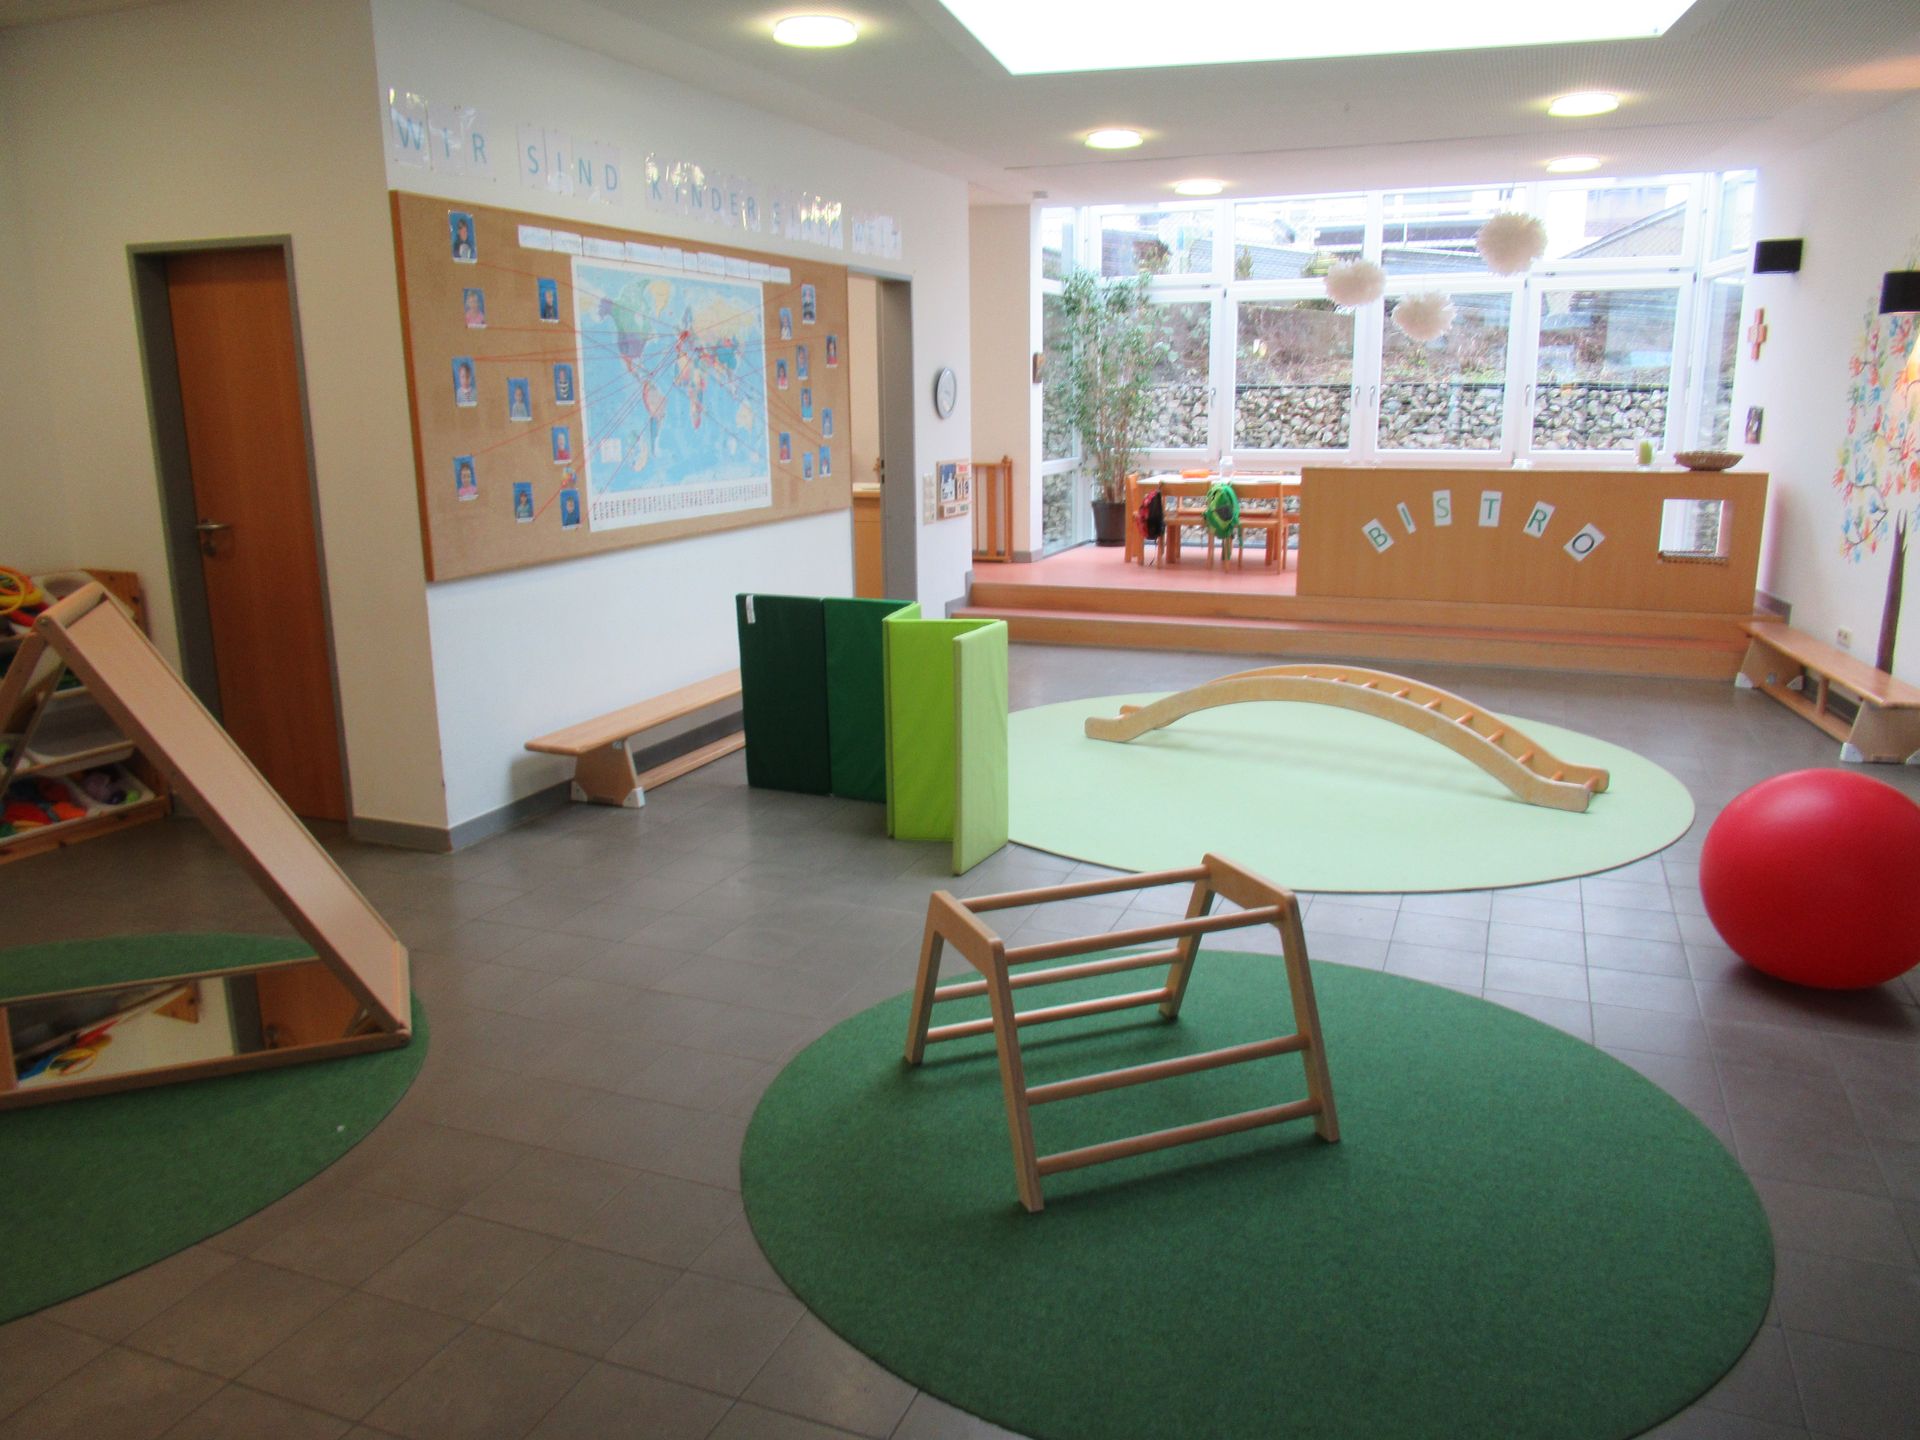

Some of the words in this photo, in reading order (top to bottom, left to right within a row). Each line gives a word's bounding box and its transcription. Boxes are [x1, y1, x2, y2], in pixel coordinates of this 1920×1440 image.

[396, 119, 487, 164] WIR
[527, 146, 618, 191] SIND
[651, 175, 757, 222] KINDER
[1367, 497, 1596, 554] BISTRO
